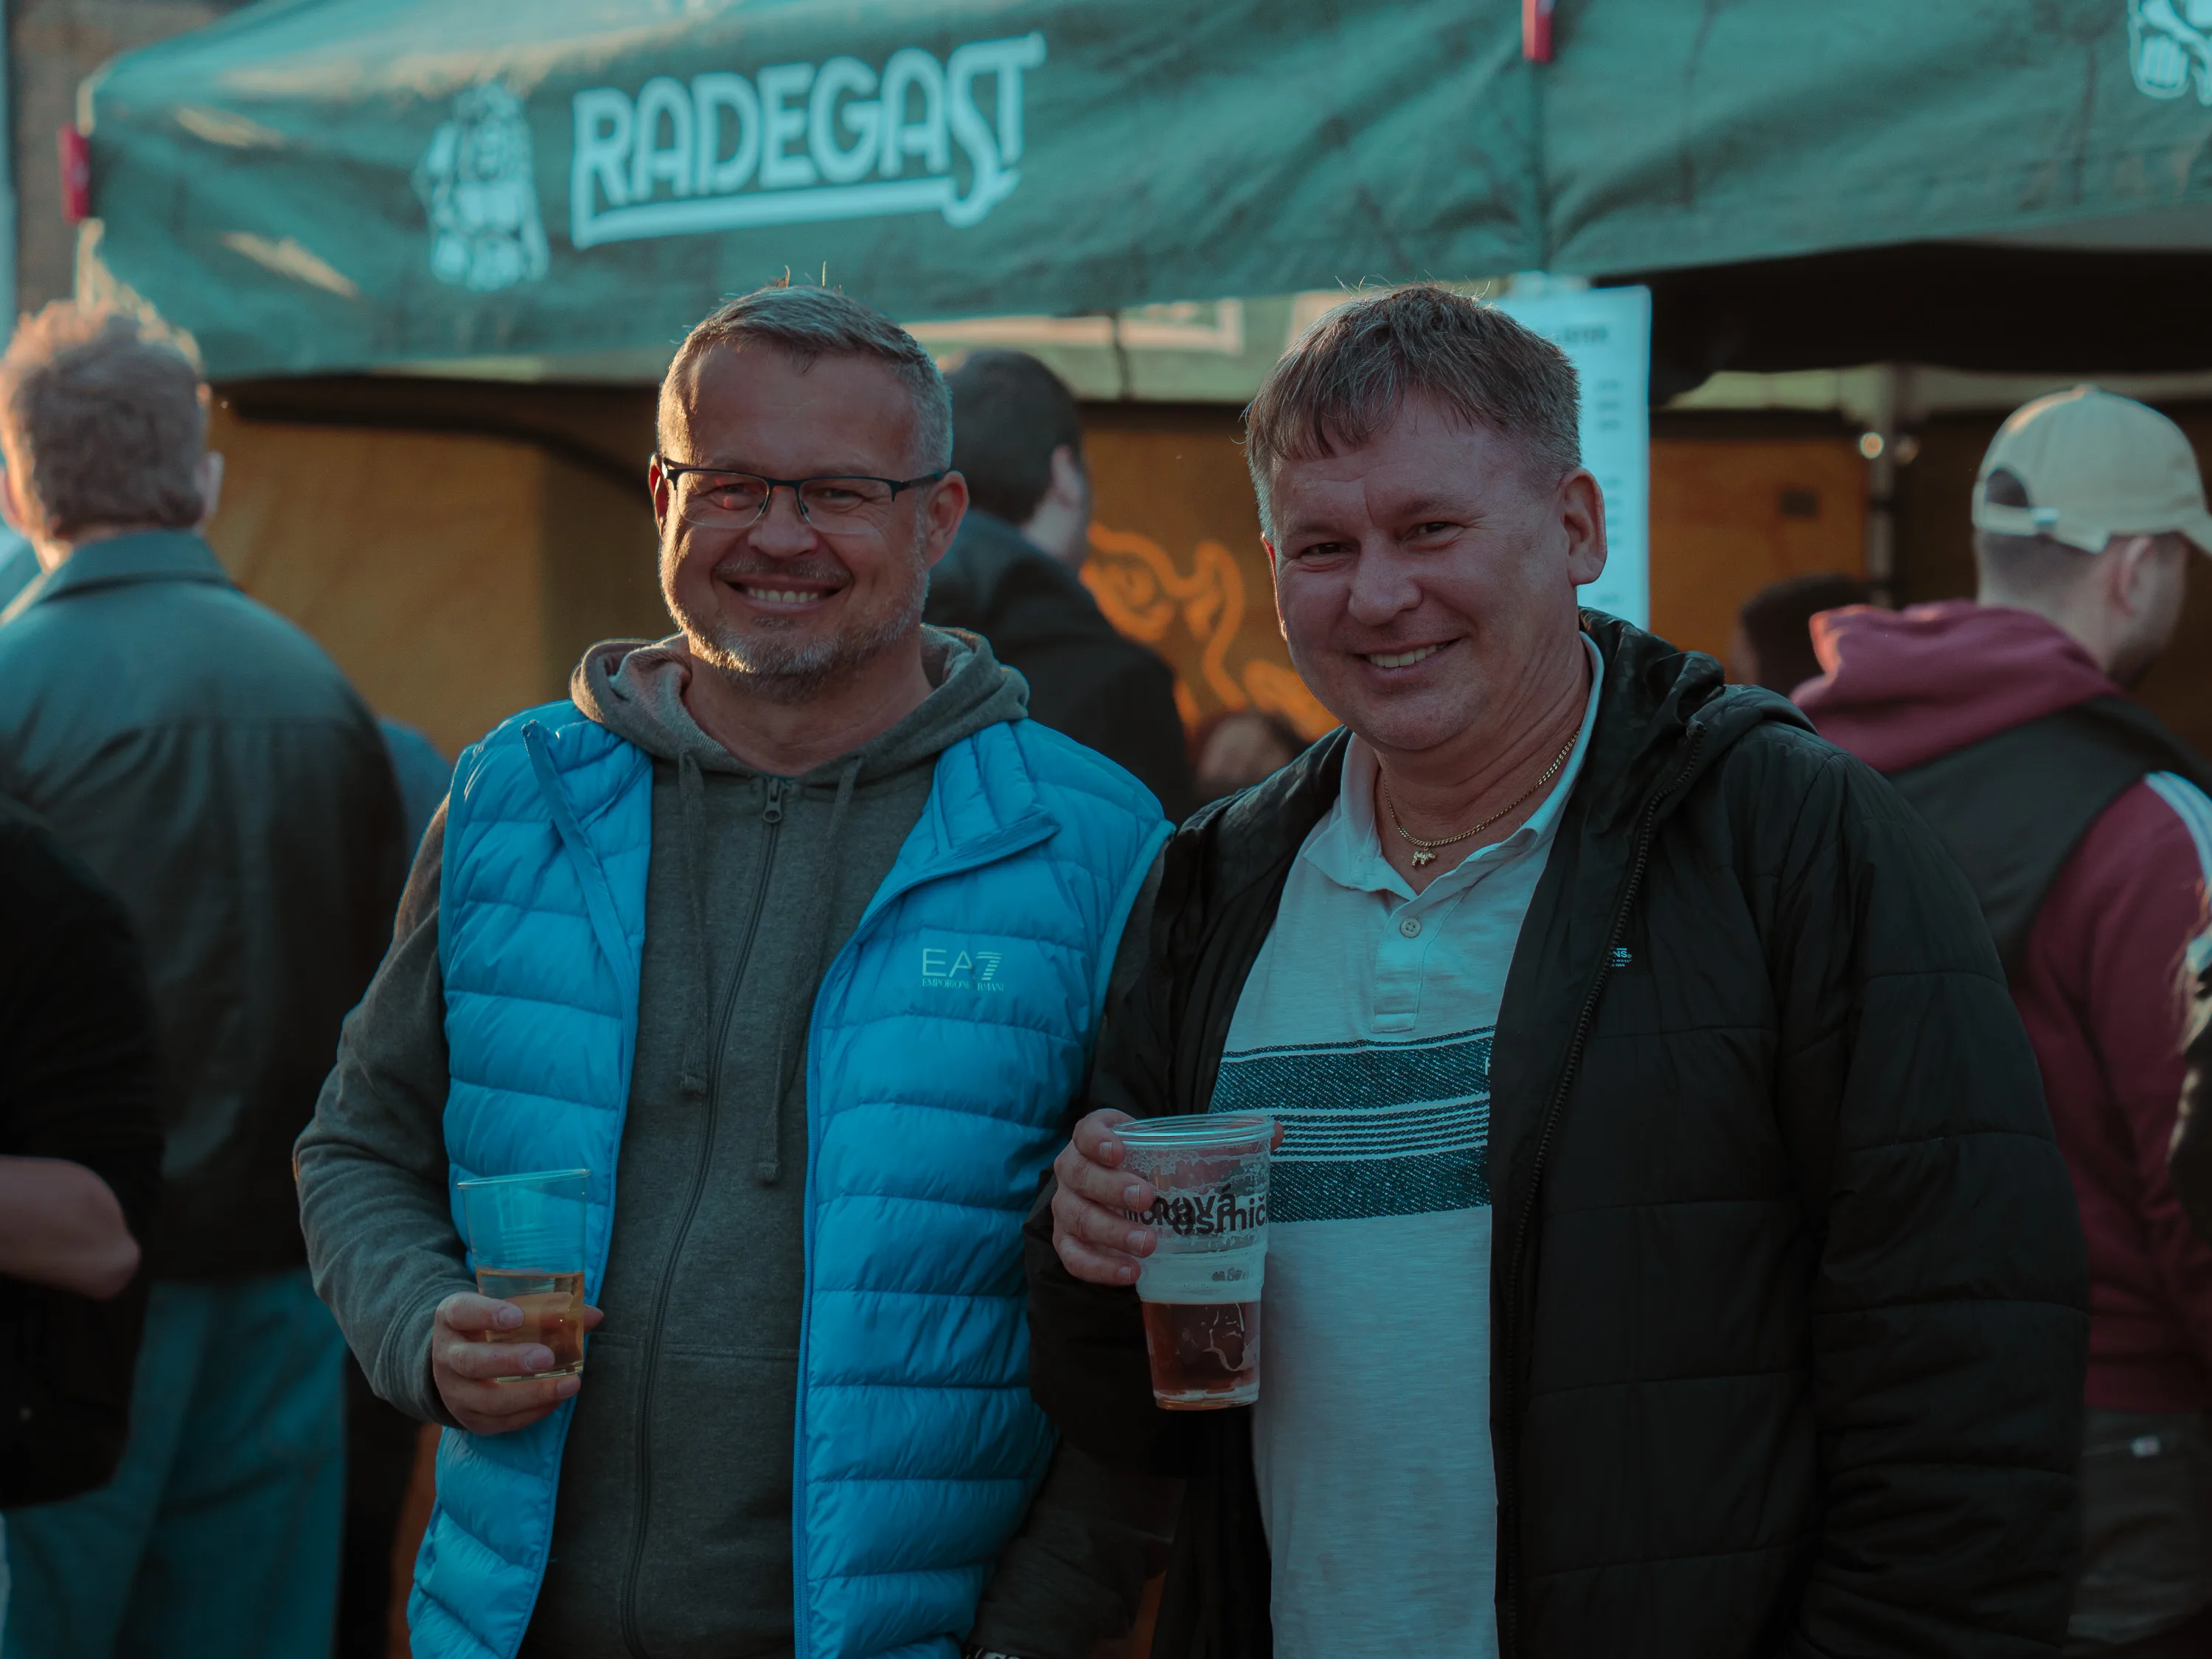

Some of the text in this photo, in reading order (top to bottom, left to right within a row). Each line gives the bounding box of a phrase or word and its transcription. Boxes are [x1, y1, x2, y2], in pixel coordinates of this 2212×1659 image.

[570, 30, 1047, 249] RADEGAST
[922, 948, 1003, 981] EA7
[922, 978, 1004, 992] EMPORIO RMANI
[1172, 1193, 1269, 1235] osmič
